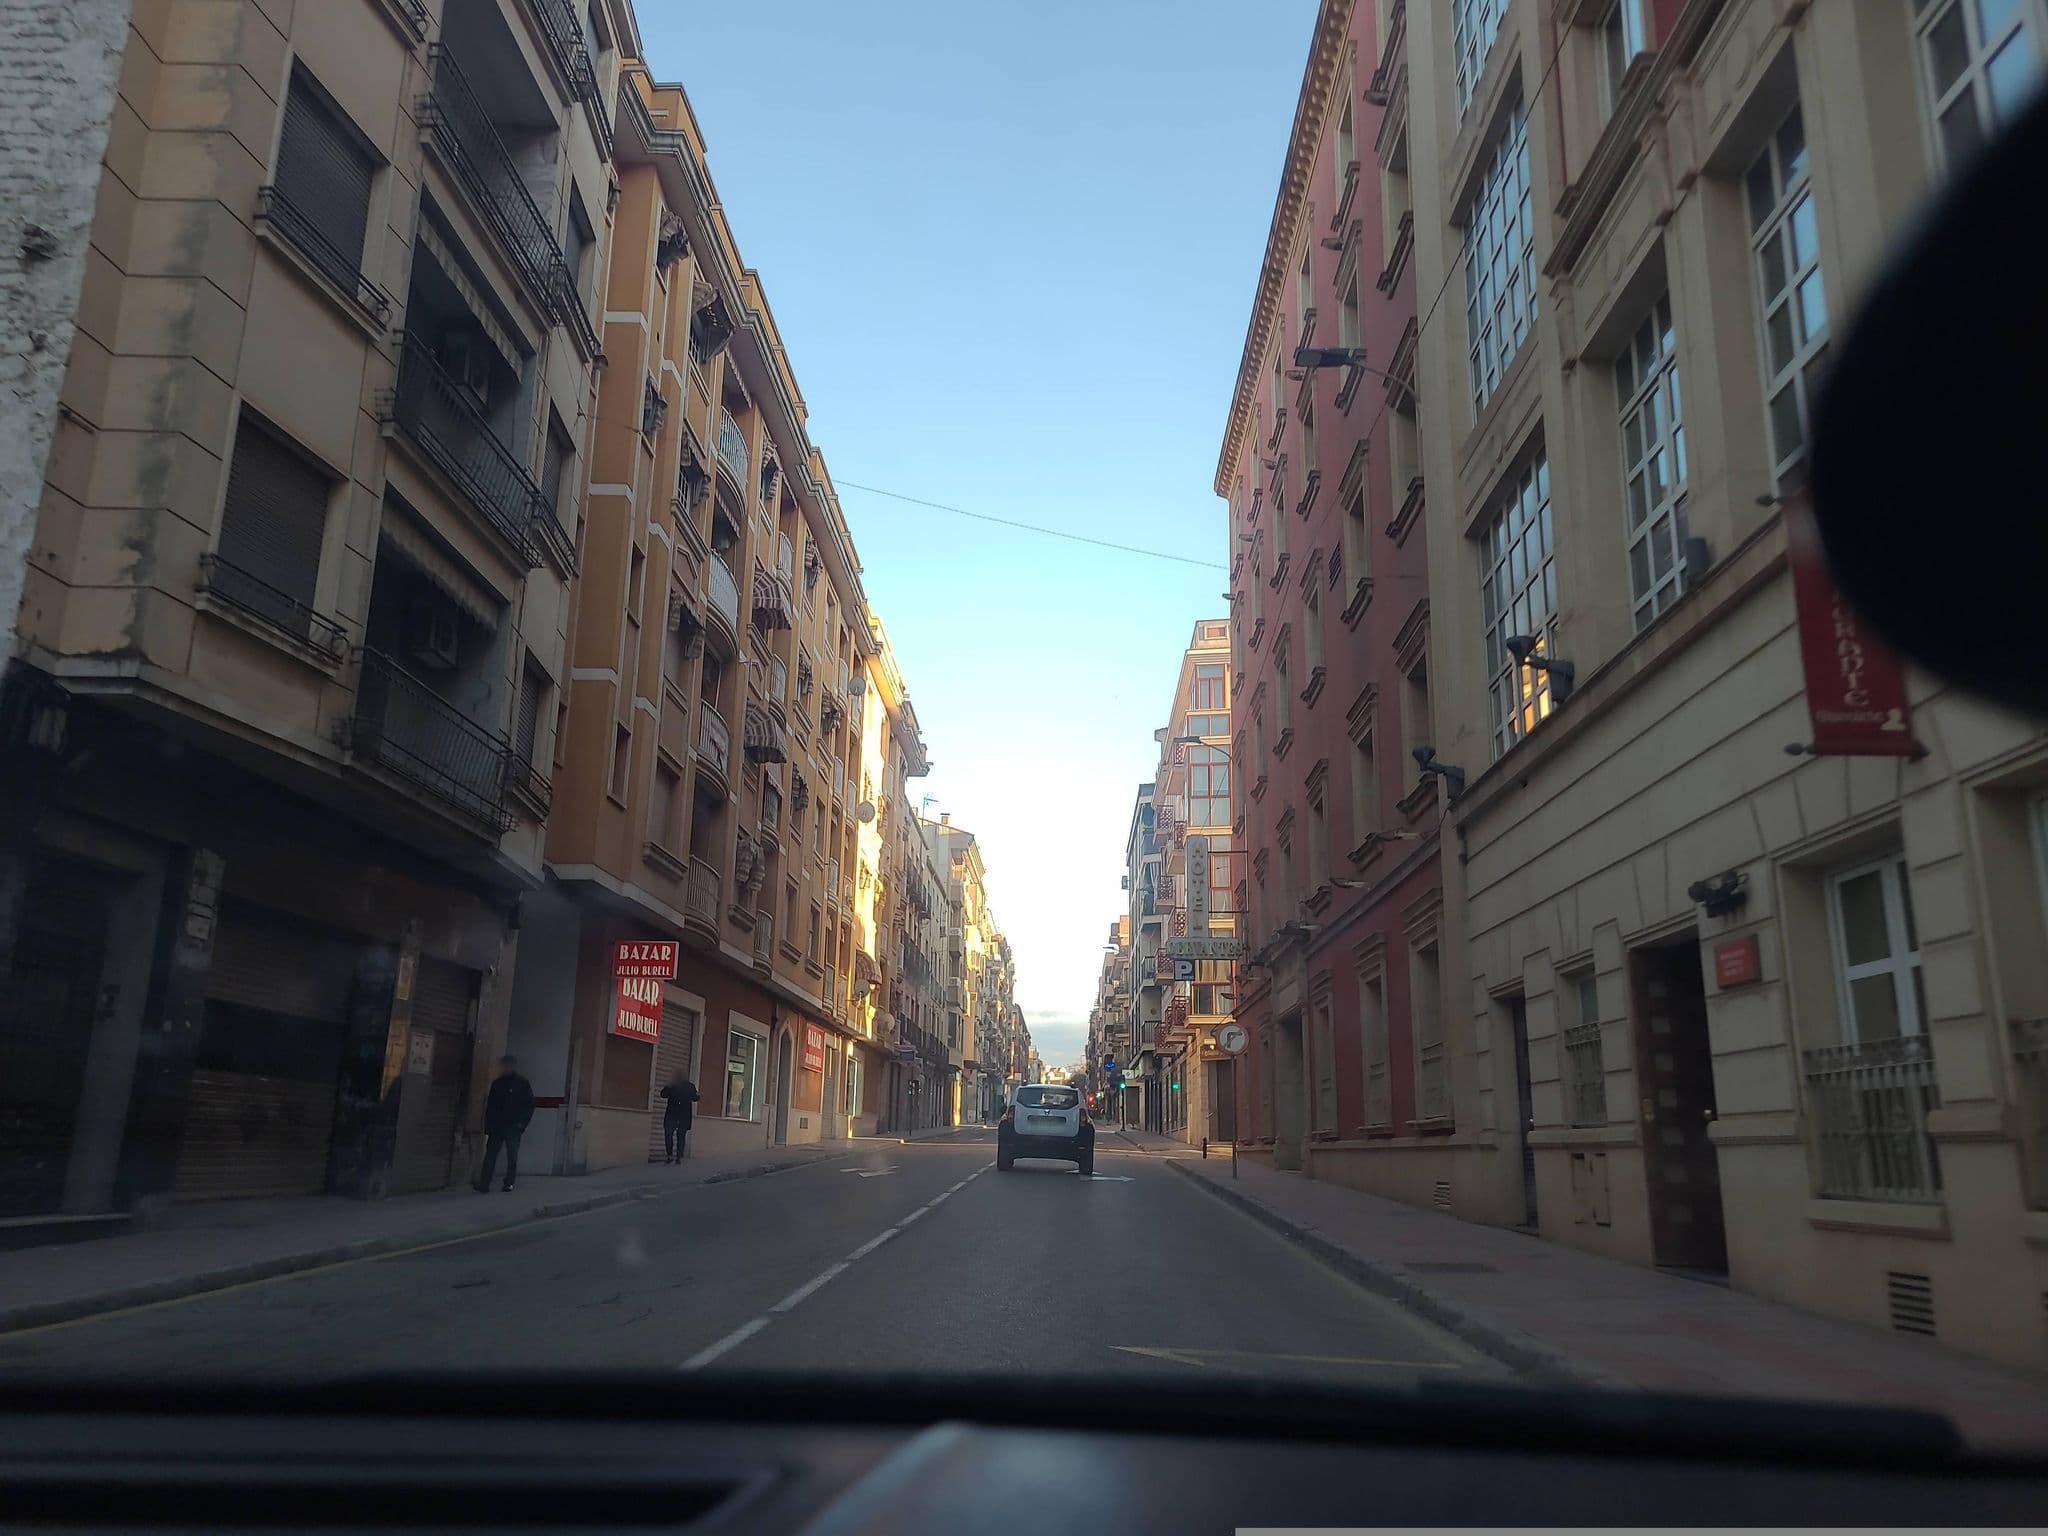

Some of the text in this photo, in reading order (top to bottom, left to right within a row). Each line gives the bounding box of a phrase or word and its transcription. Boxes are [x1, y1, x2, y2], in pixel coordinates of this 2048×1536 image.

[1192, 841, 1205, 930] HOTEL
[619, 944, 672, 961] BAZAR
[616, 965, 672, 976] JULIO BURELL
[1175, 961, 1193, 980] P
[622, 978, 660, 1007] BAZAR
[618, 1009, 658, 1037] JULIO BURELL
